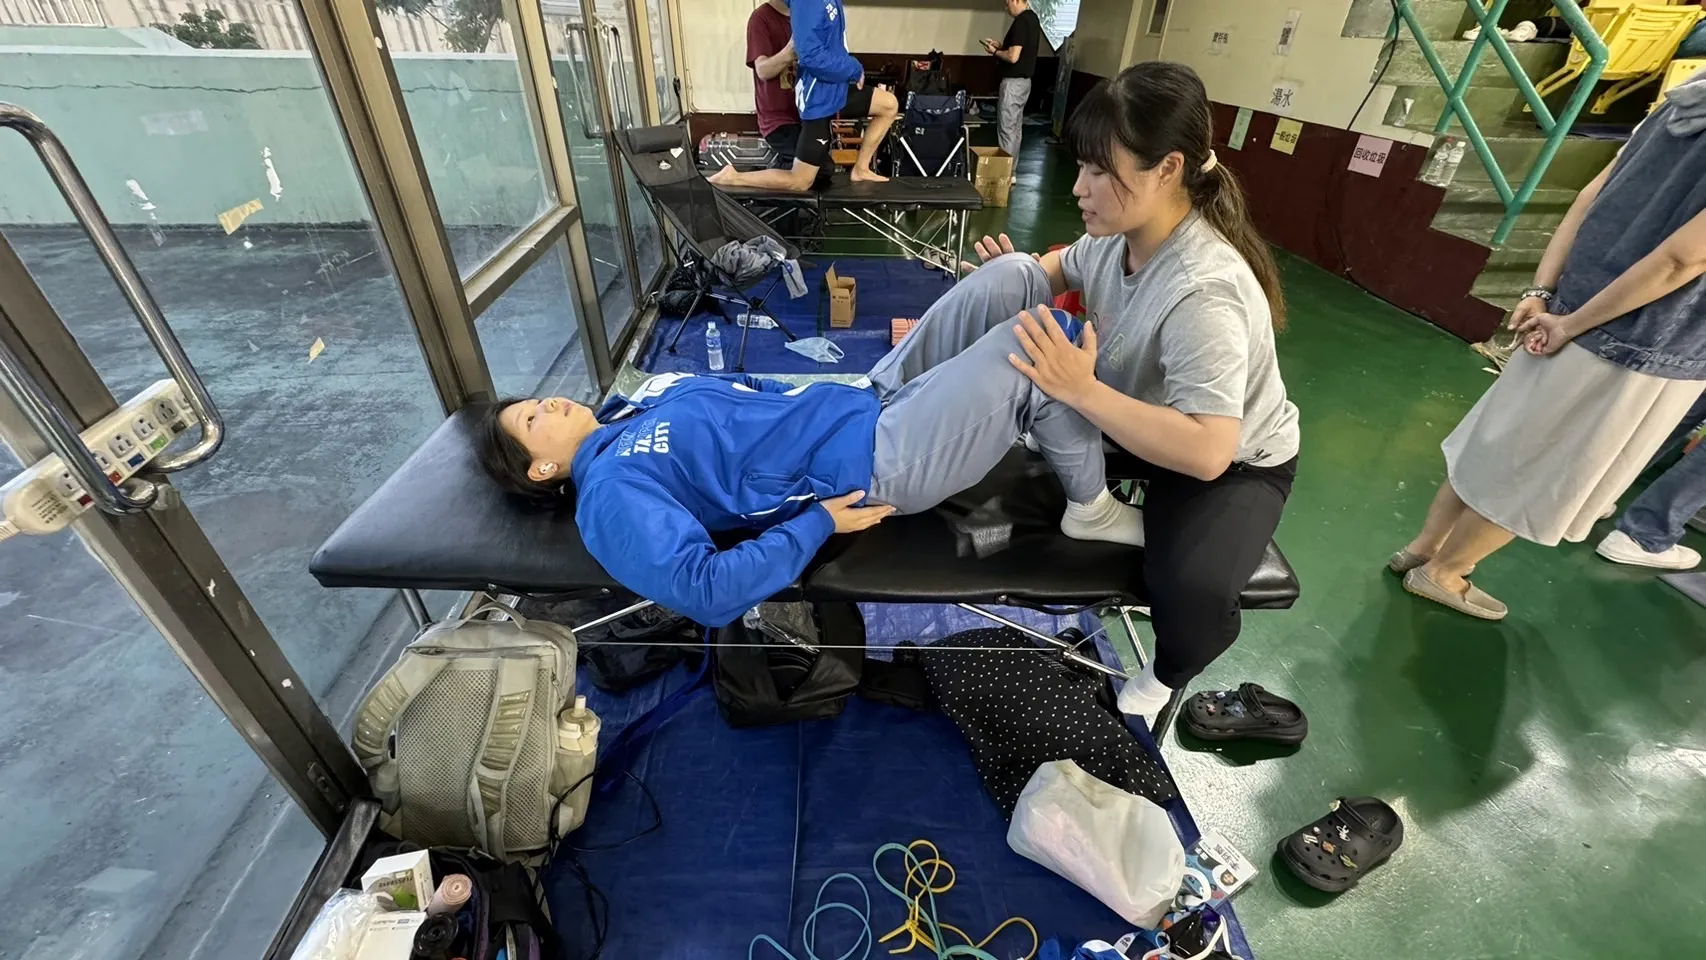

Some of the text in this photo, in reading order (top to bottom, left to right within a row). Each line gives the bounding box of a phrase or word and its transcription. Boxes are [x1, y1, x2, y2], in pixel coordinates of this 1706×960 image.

[1353, 147, 1386, 164] 回收垃圾
[653, 421, 670, 453] CITY
